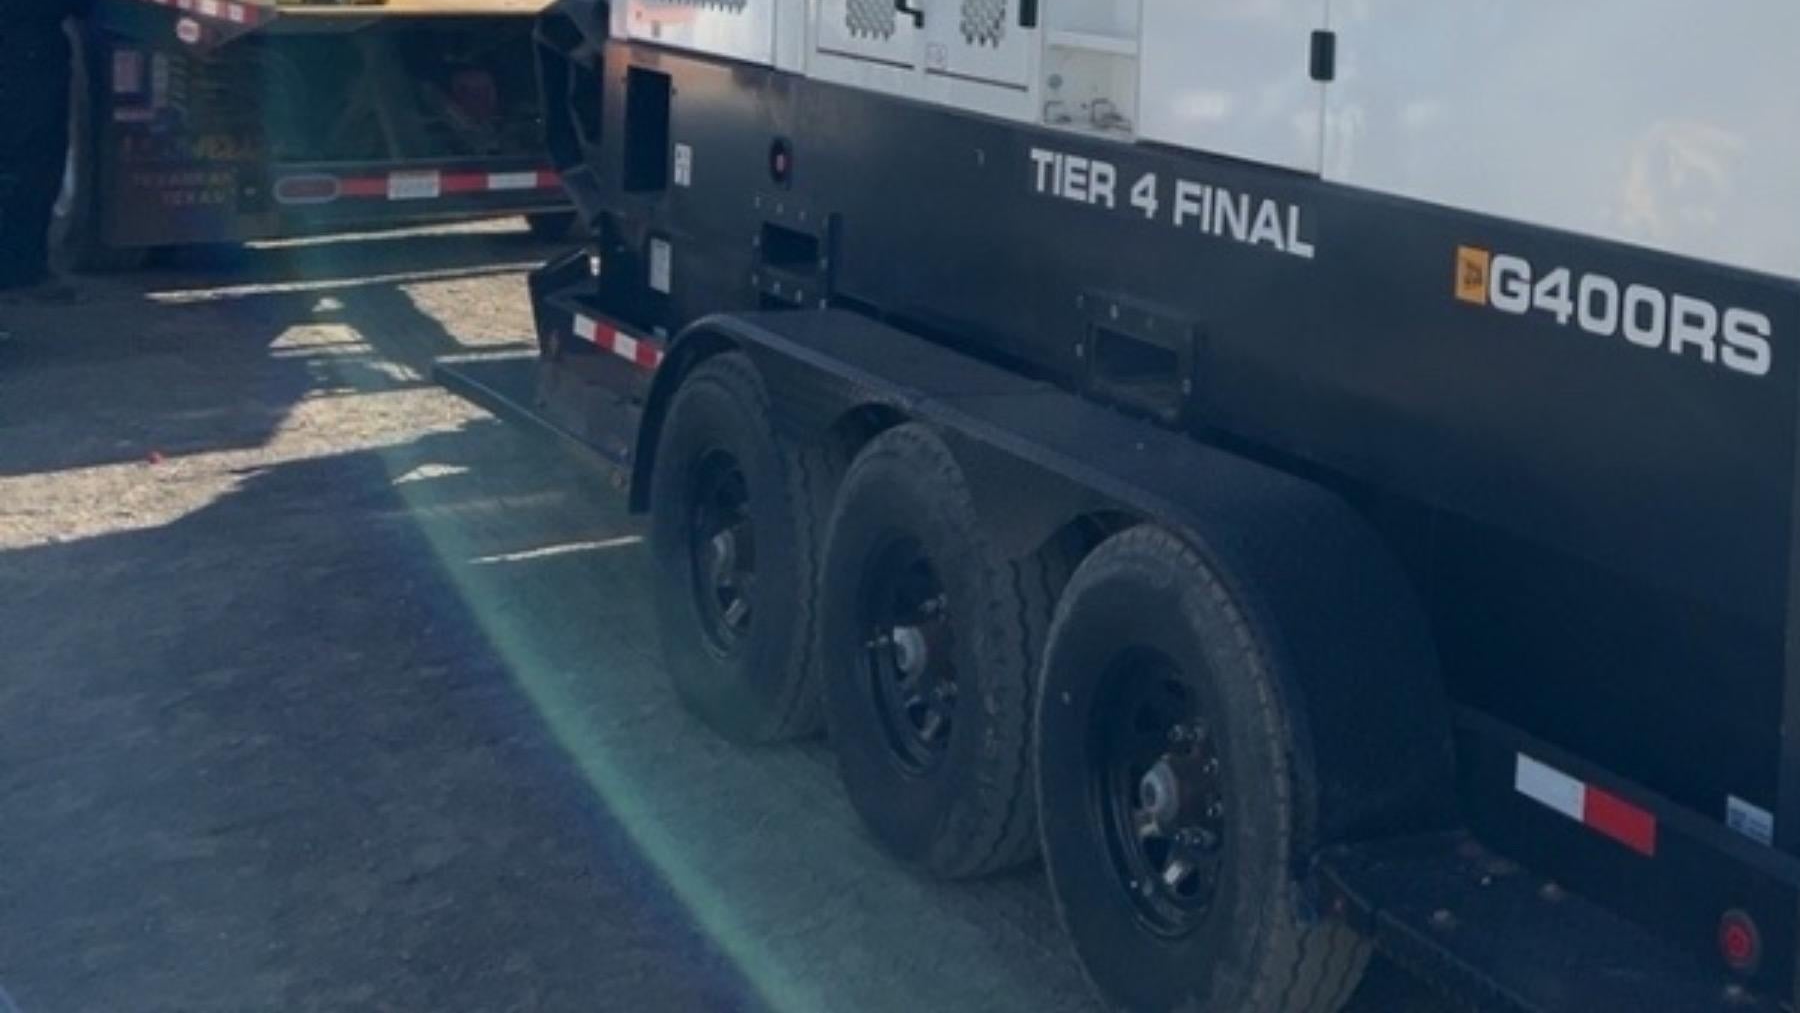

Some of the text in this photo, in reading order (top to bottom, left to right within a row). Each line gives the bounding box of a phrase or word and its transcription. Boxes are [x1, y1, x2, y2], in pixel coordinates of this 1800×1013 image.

[1030, 147, 1315, 259] TIER 4 FINAL
[1490, 253, 1772, 376] G400RS
